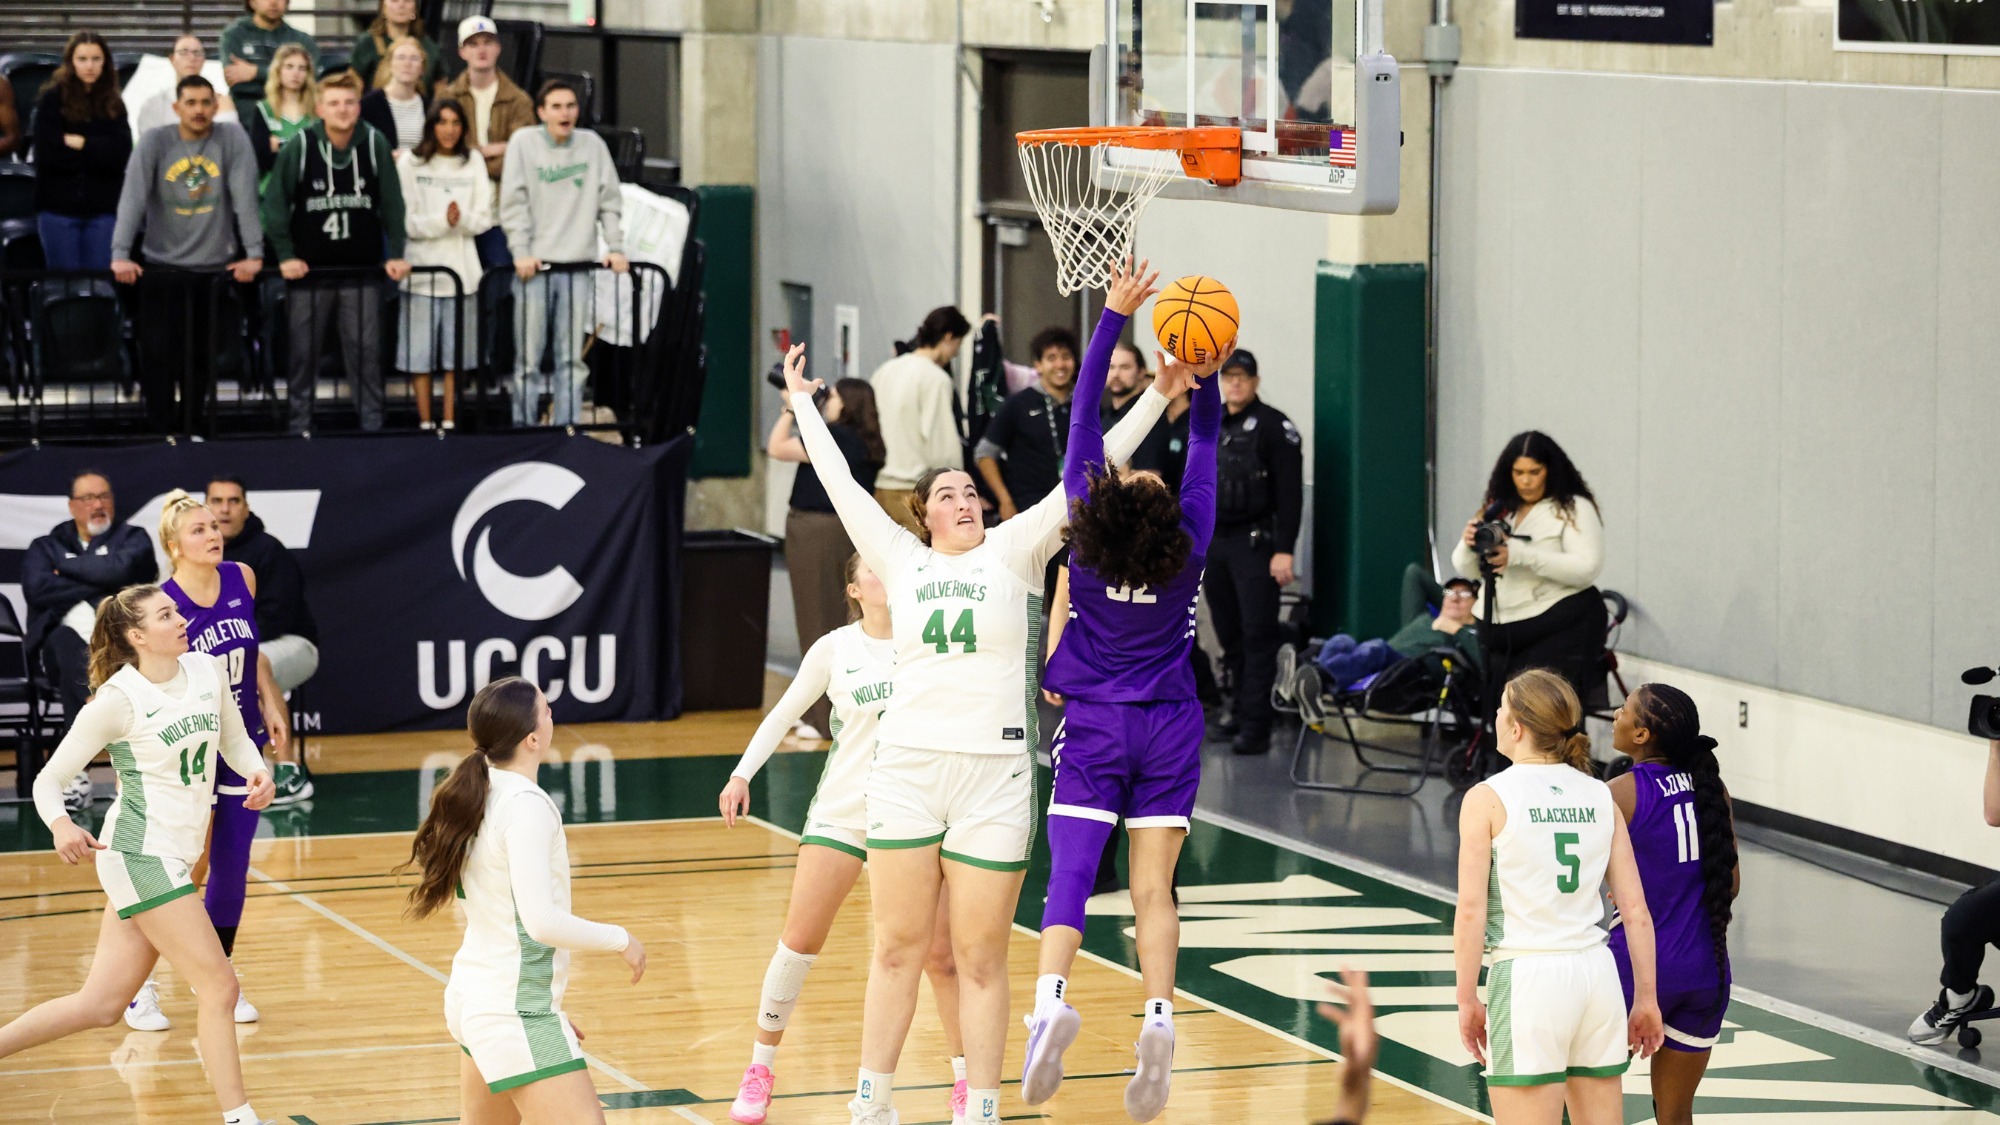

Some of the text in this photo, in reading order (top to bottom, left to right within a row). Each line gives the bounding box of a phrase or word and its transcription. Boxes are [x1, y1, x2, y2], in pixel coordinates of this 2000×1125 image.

[322, 211, 350, 240] 41
[916, 580, 987, 603] WOLVERINES
[191, 618, 254, 653] TARLETON
[922, 608, 977, 654] 44
[417, 634, 617, 710] UCCU
[157, 713, 219, 747] WOLVERINES
[180, 741, 208, 786] 14
[1528, 807, 1597, 823] BLACKHAM
[1673, 801, 1700, 863] 11
[1553, 832, 1581, 893] 5
